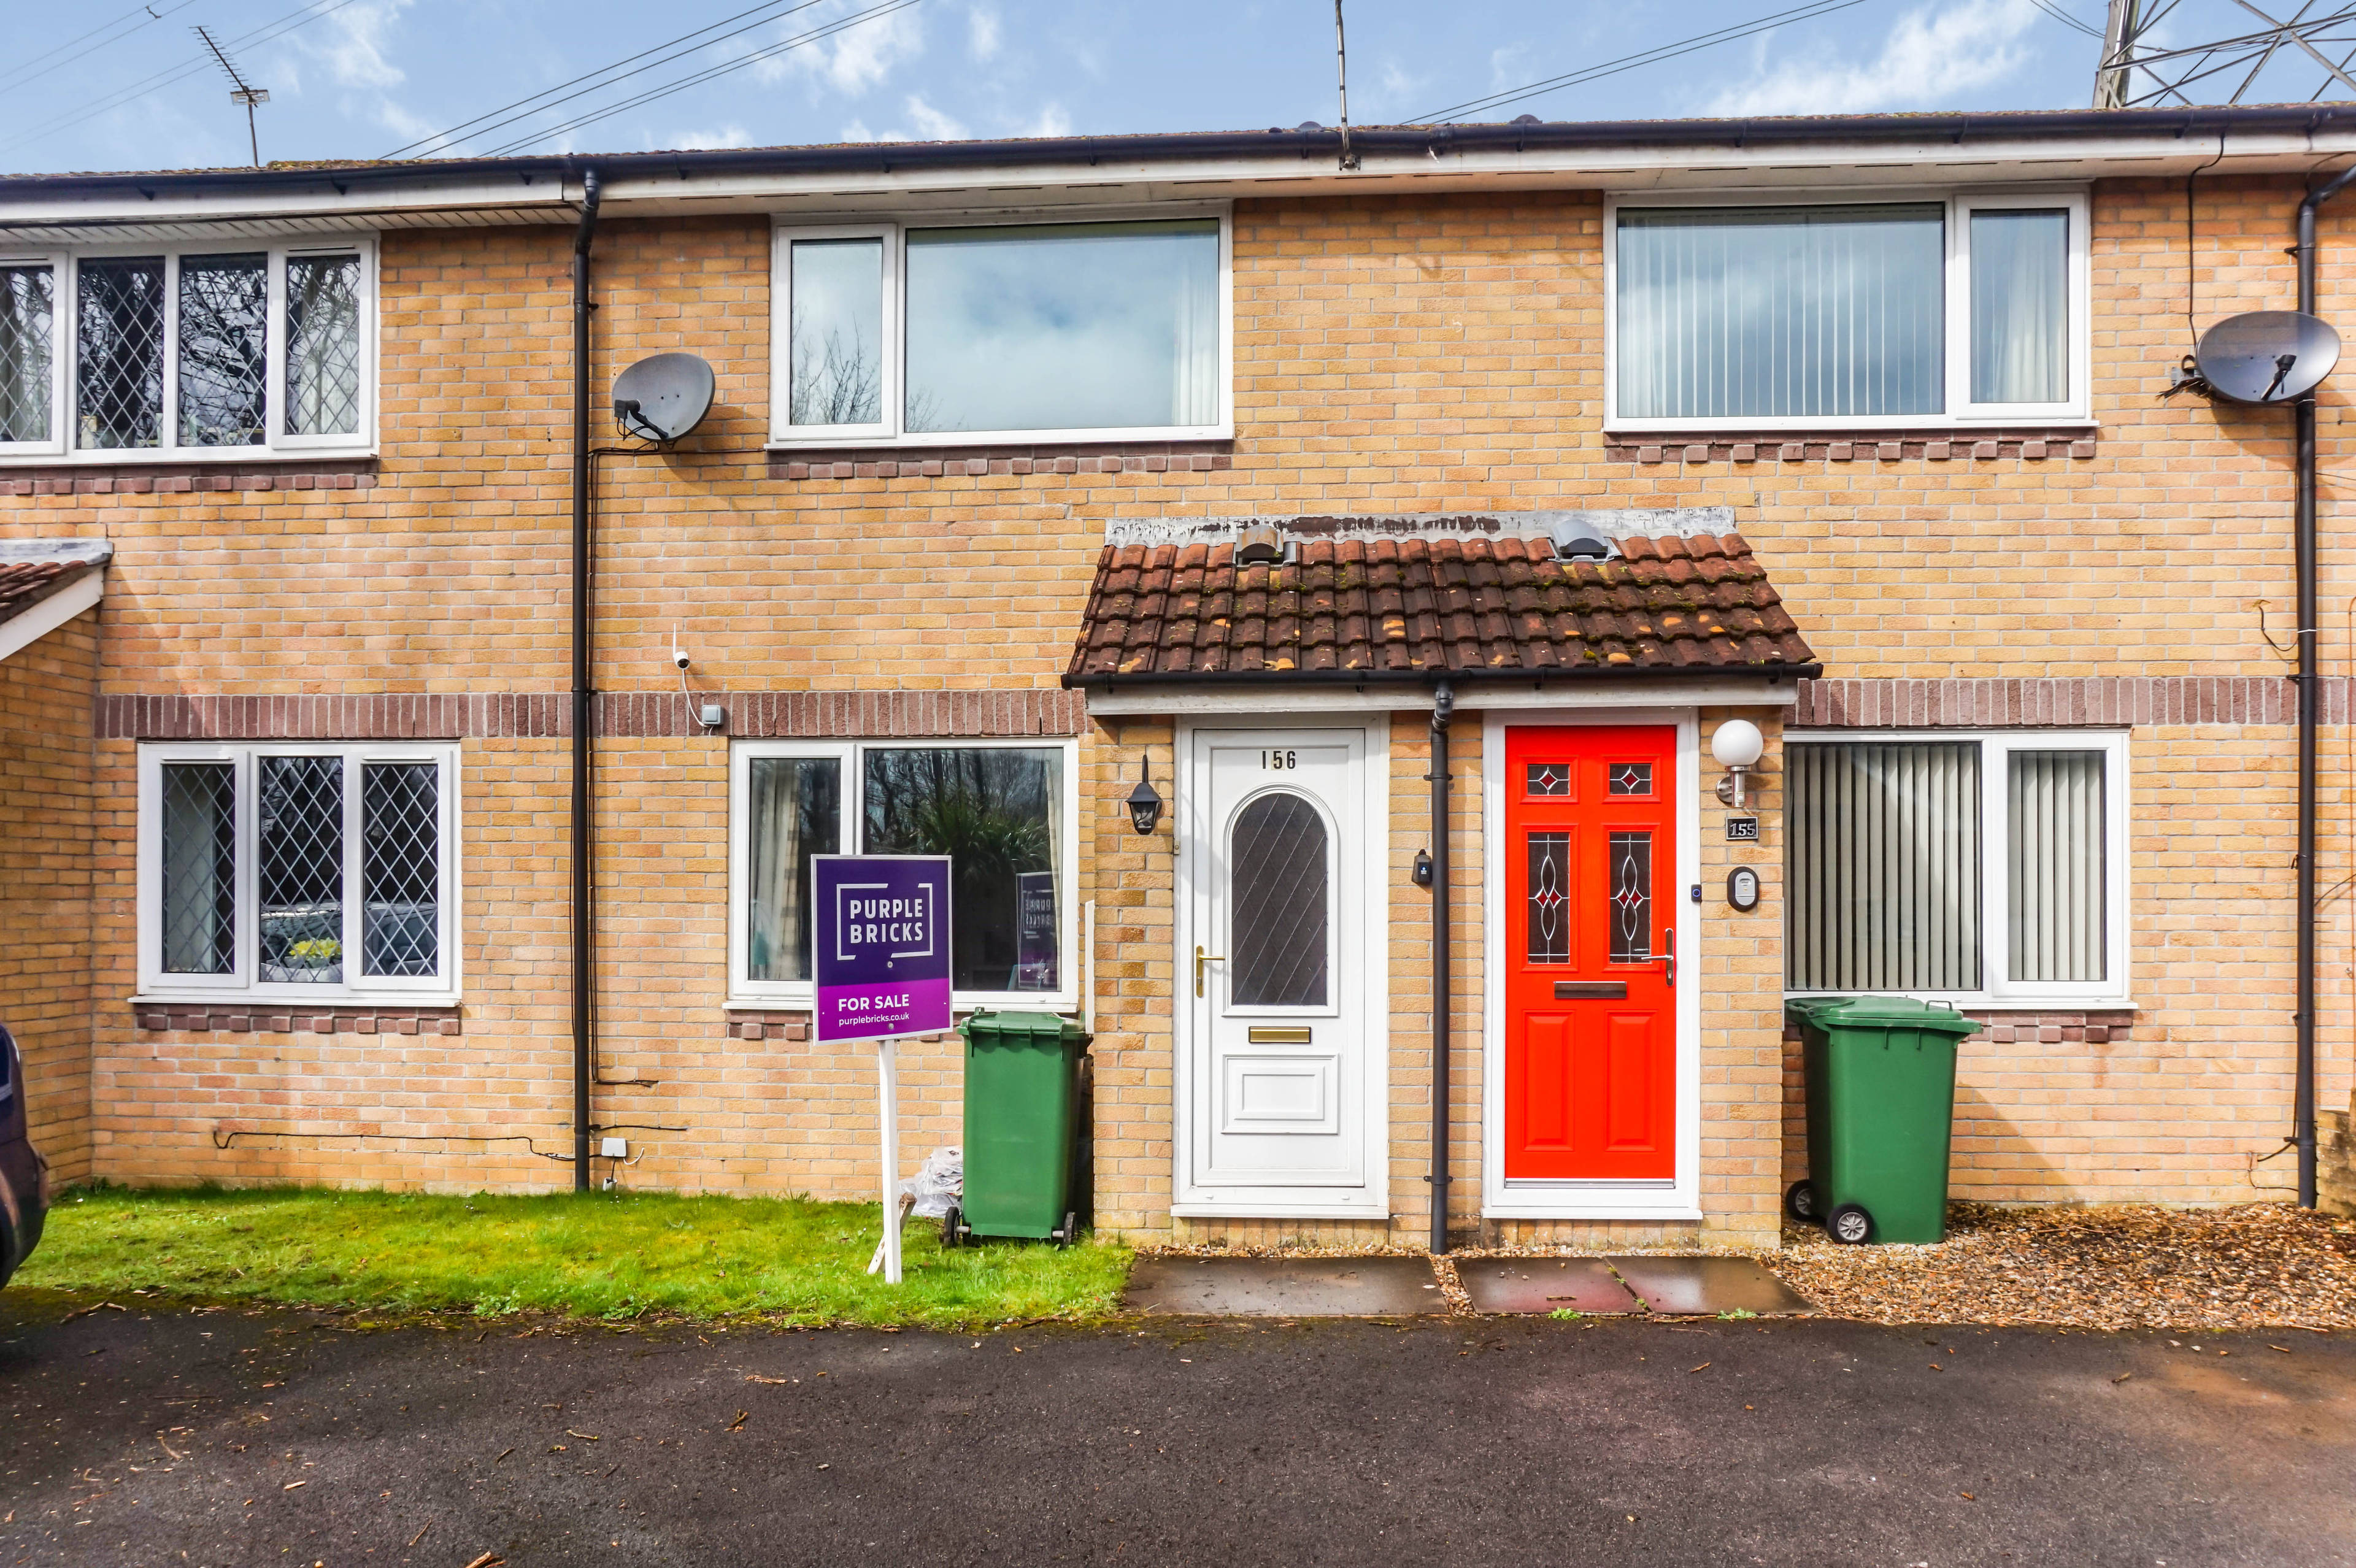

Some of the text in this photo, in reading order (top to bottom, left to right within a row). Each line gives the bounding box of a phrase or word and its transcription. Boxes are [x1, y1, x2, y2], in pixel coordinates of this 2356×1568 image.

[1262, 750, 1296, 769] 156
[1730, 823, 1755, 836] 155
[850, 899, 923, 919] PURPLE
[850, 922, 923, 943] BRICKS
[838, 994, 909, 1012] FOR SALE
[839, 1012, 909, 1027] purplebricks.co.uk
